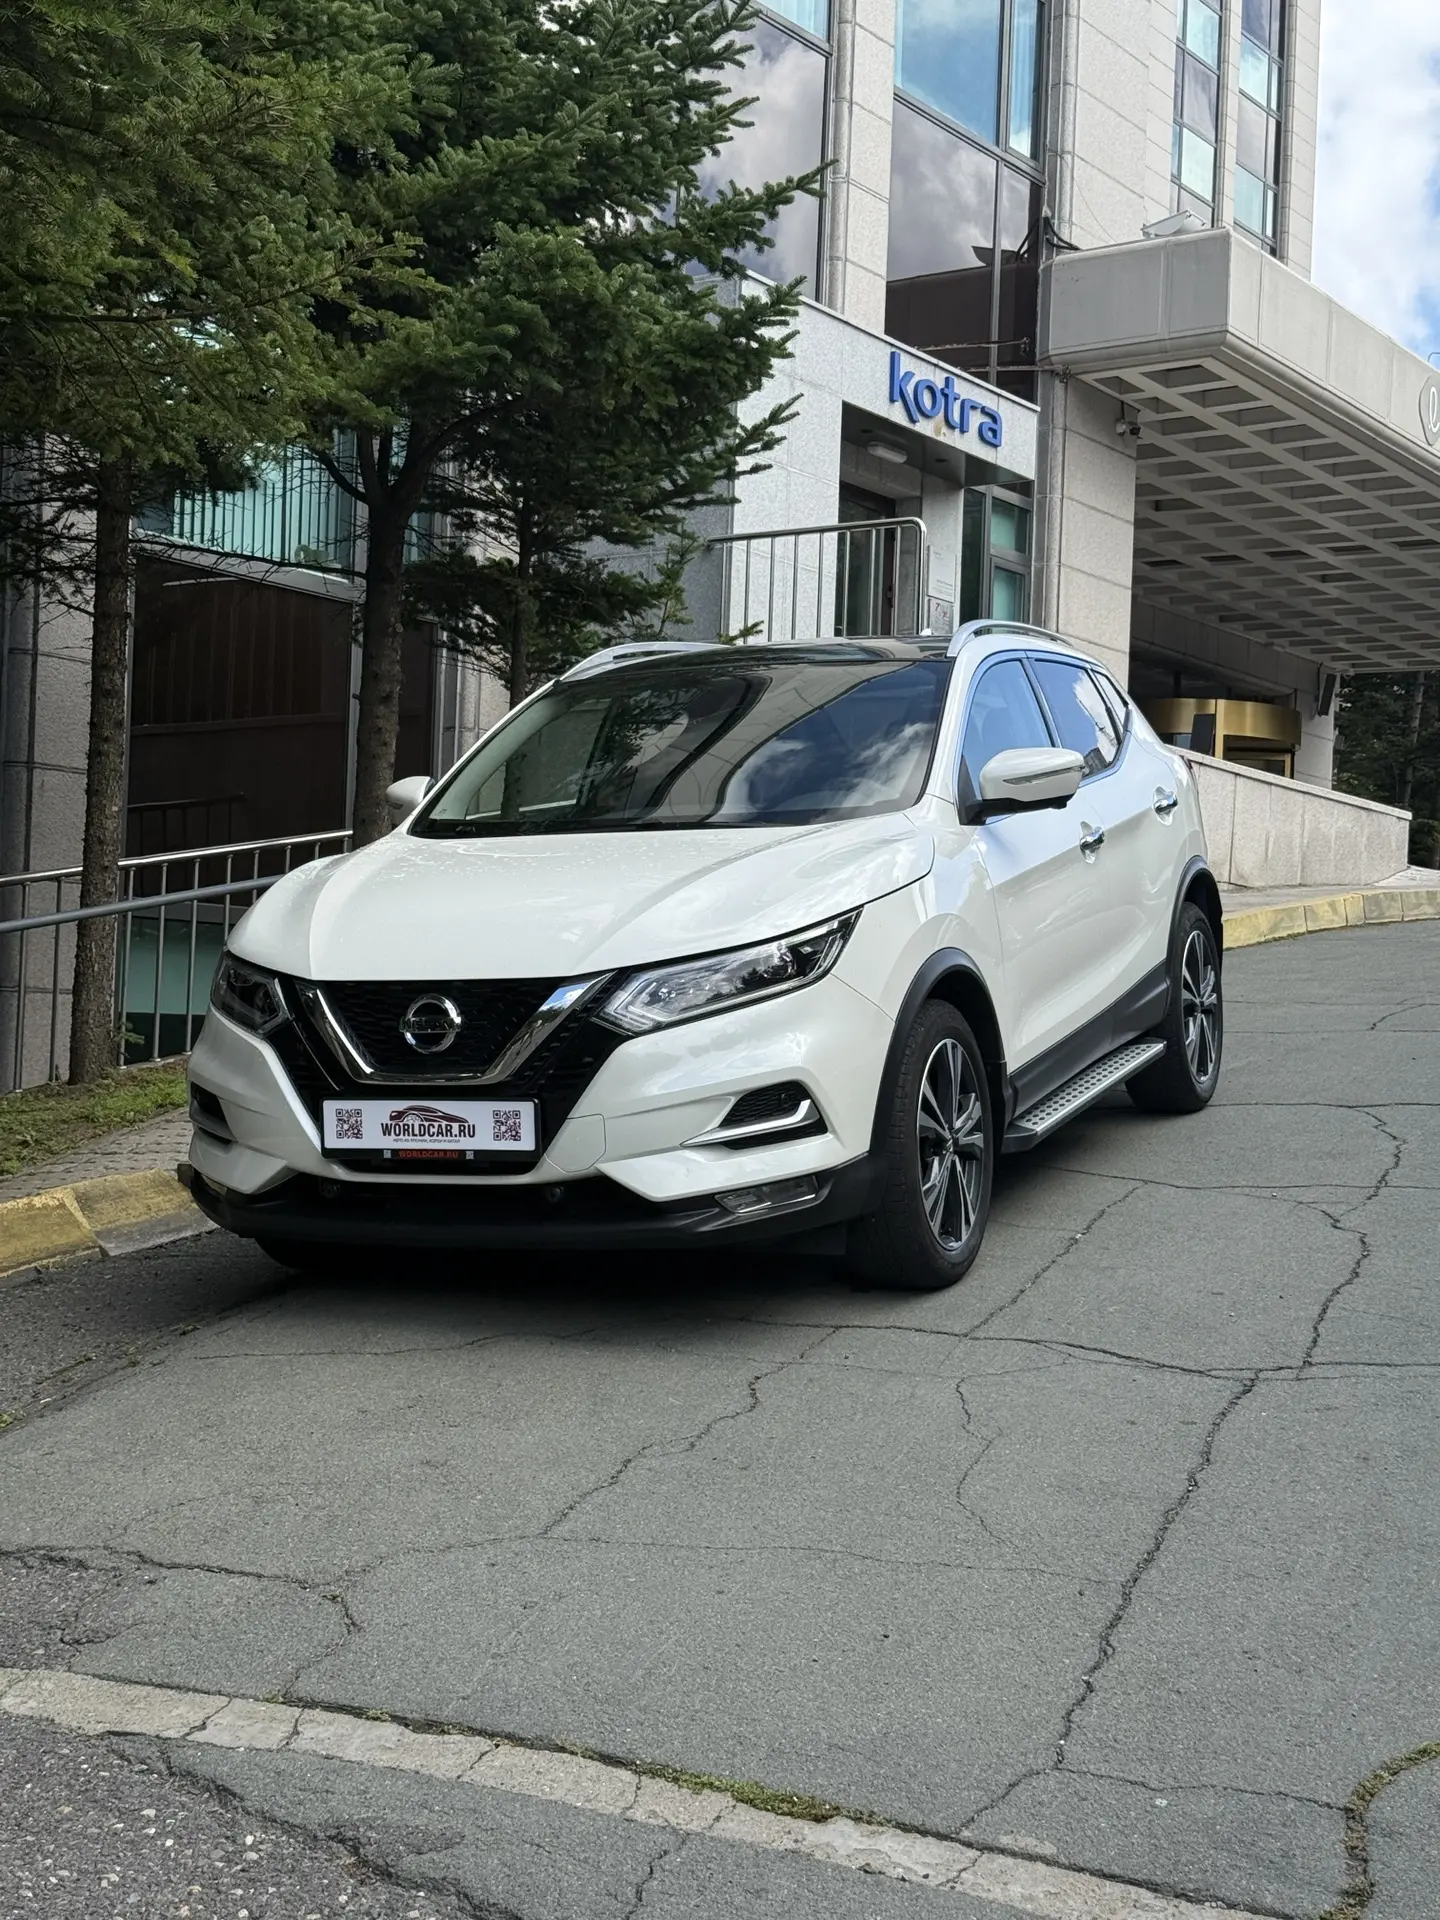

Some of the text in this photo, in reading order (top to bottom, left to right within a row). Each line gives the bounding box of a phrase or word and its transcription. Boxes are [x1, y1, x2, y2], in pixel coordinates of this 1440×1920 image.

[889, 351, 1003, 447] kotra
[381, 1123, 475, 1138] WORLDCAR.RU
[399, 1151, 459, 1159] WORLDCAR.RU
